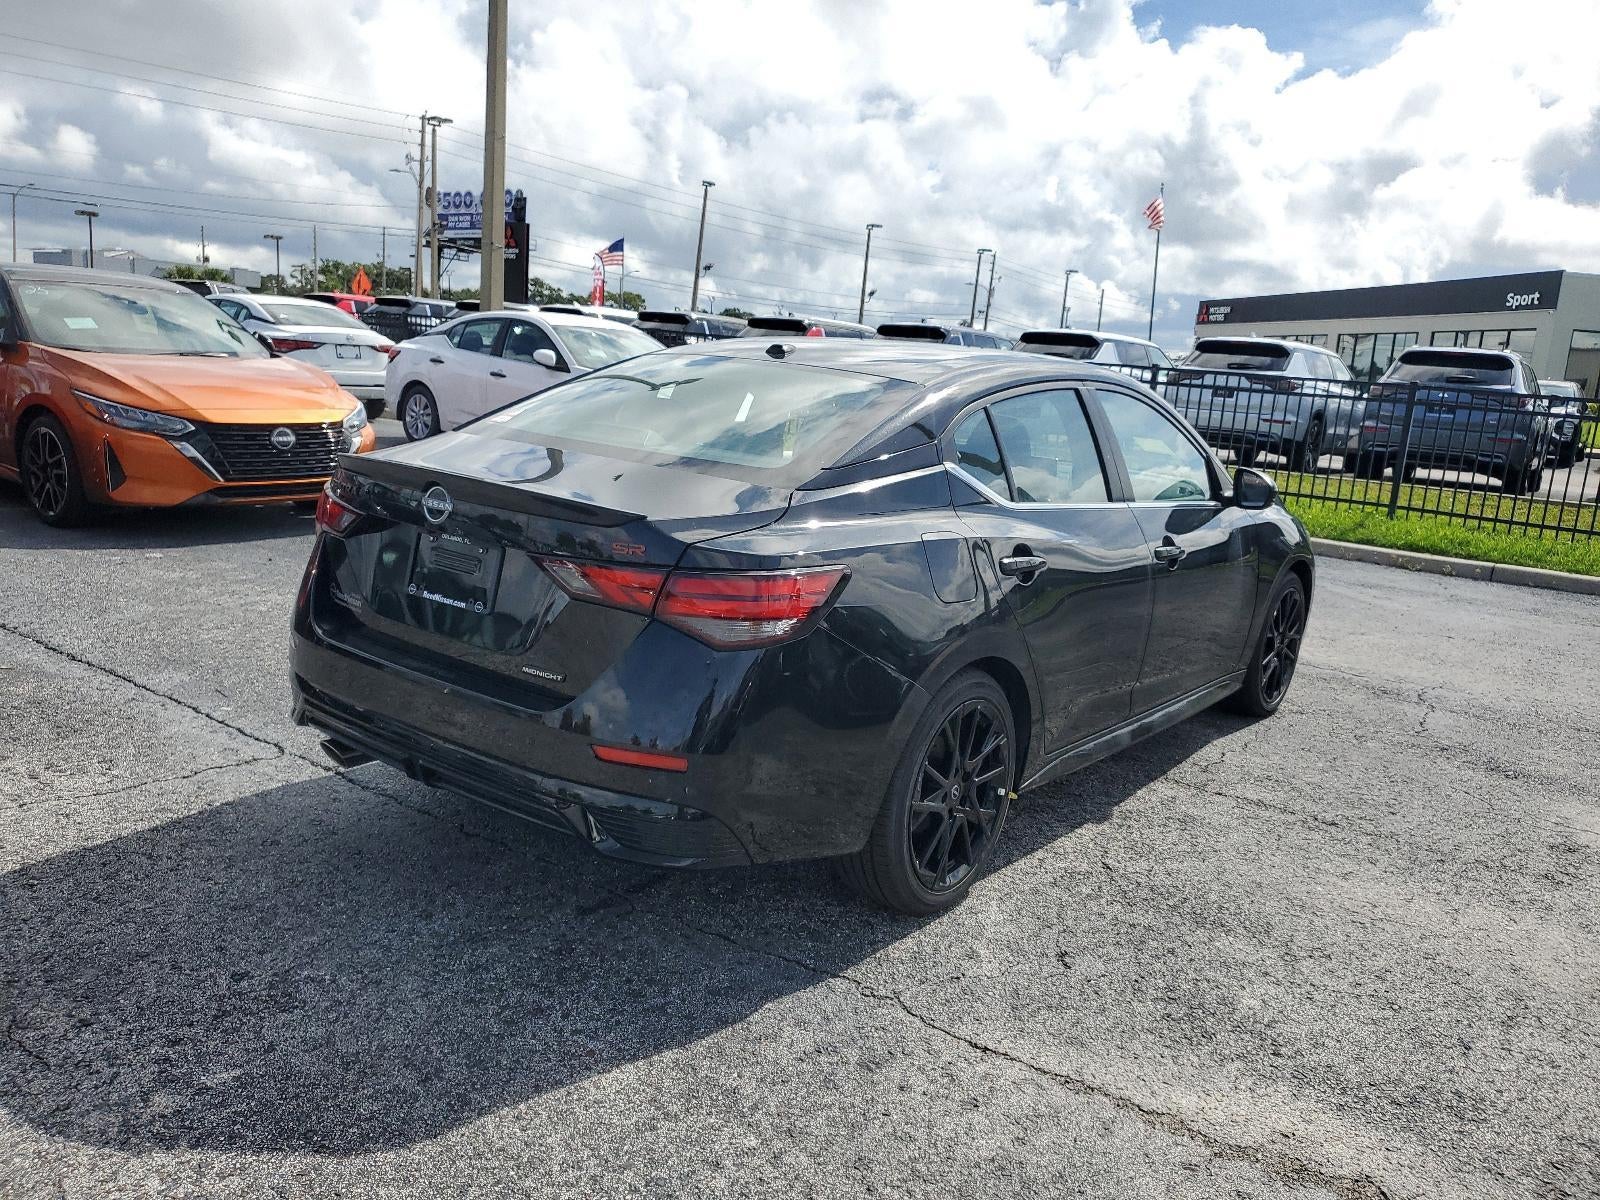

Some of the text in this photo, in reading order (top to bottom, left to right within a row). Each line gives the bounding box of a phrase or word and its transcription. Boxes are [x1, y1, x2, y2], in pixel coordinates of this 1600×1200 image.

[1505, 291, 1540, 309] Sport
[422, 496, 453, 512] NISSAN
[612, 542, 646, 556] SR
[422, 590, 466, 609] ReedNissan.com
[521, 666, 563, 682] MIDNIGHT
